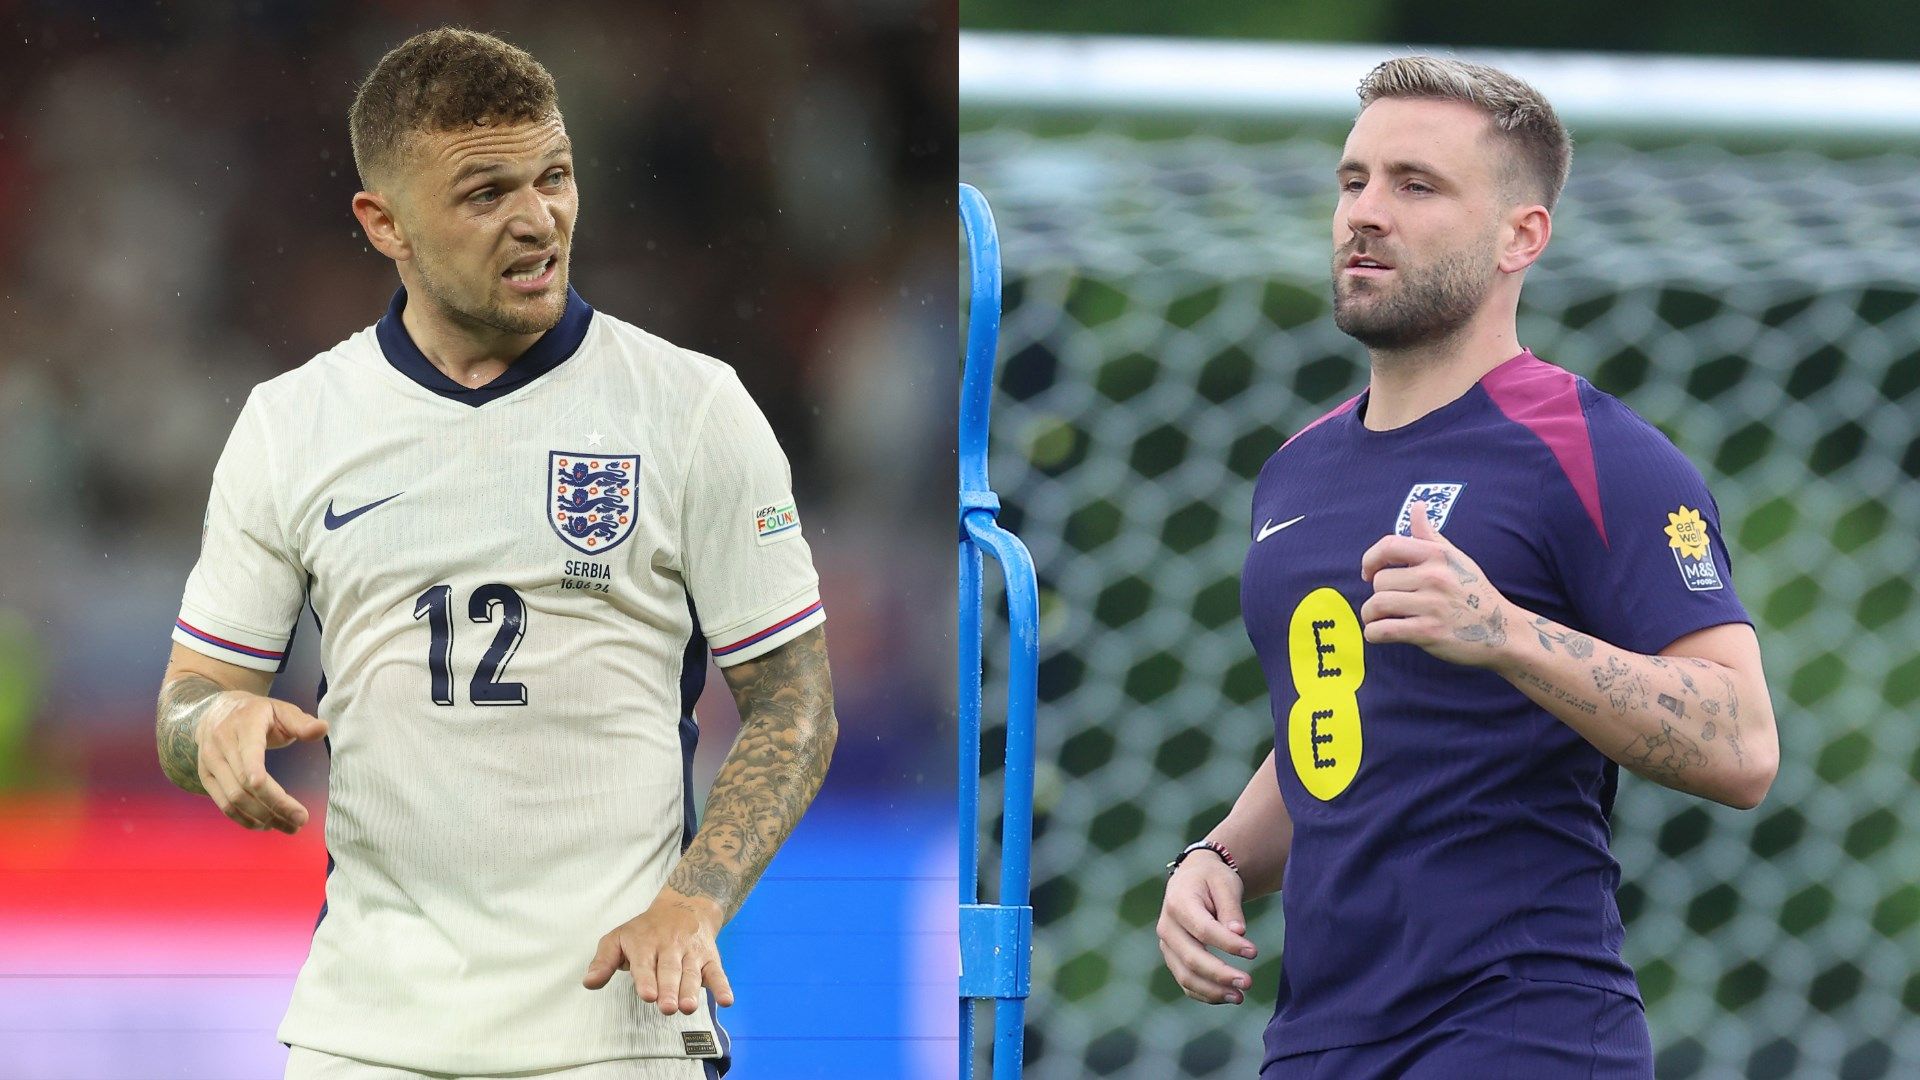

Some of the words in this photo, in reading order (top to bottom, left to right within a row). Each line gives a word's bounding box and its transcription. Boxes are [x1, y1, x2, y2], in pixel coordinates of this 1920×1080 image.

[756, 506, 776, 518] UEFA
[1676, 519, 1696, 533] eat
[1679, 528, 1702, 543] well
[565, 560, 611, 580] SERBIA
[1684, 562, 1714, 579] M&S
[413, 583, 527, 706] 12
